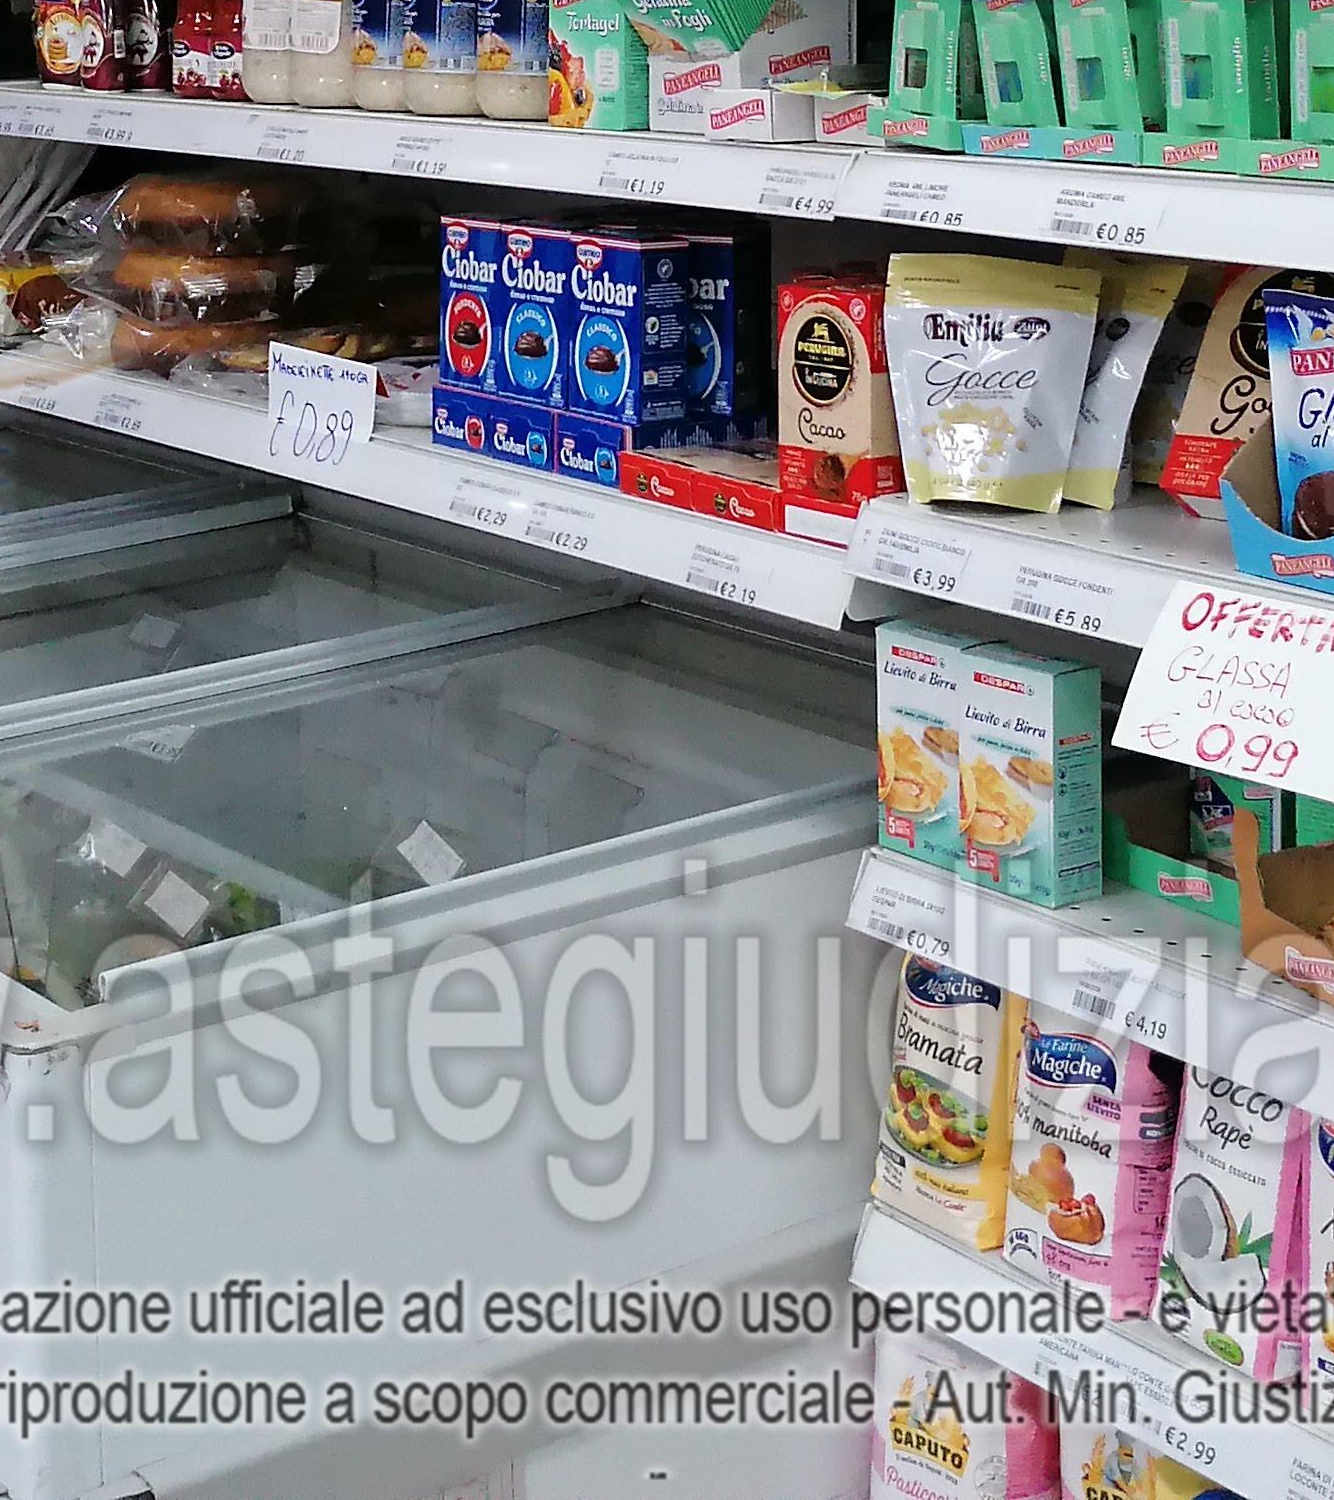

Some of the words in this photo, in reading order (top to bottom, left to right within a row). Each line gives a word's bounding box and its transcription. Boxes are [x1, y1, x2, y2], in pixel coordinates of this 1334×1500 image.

[441, 244, 497, 283] Ciobar
[501, 253, 565, 294] Ciobar
[571, 265, 636, 308] Ciobar
[925, 352, 1039, 407] Gocce
[494, 430, 525, 457] Ciobar
[798, 407, 845, 443] Cacao
[560, 448, 593, 473] Ciobar
[1167, 645, 1291, 693] GLASSA
[965, 705, 1000, 727] Lievito
[1013, 718, 1046, 739] Birra
[898, 1011, 982, 1076] Bramata
[1032, 1051, 1103, 1080] Magiche
[1033, 1118, 1111, 1160] manitoba
[1200, 1106, 1252, 1151] Rapè
[893, 1428, 963, 1469] CAPUTO
